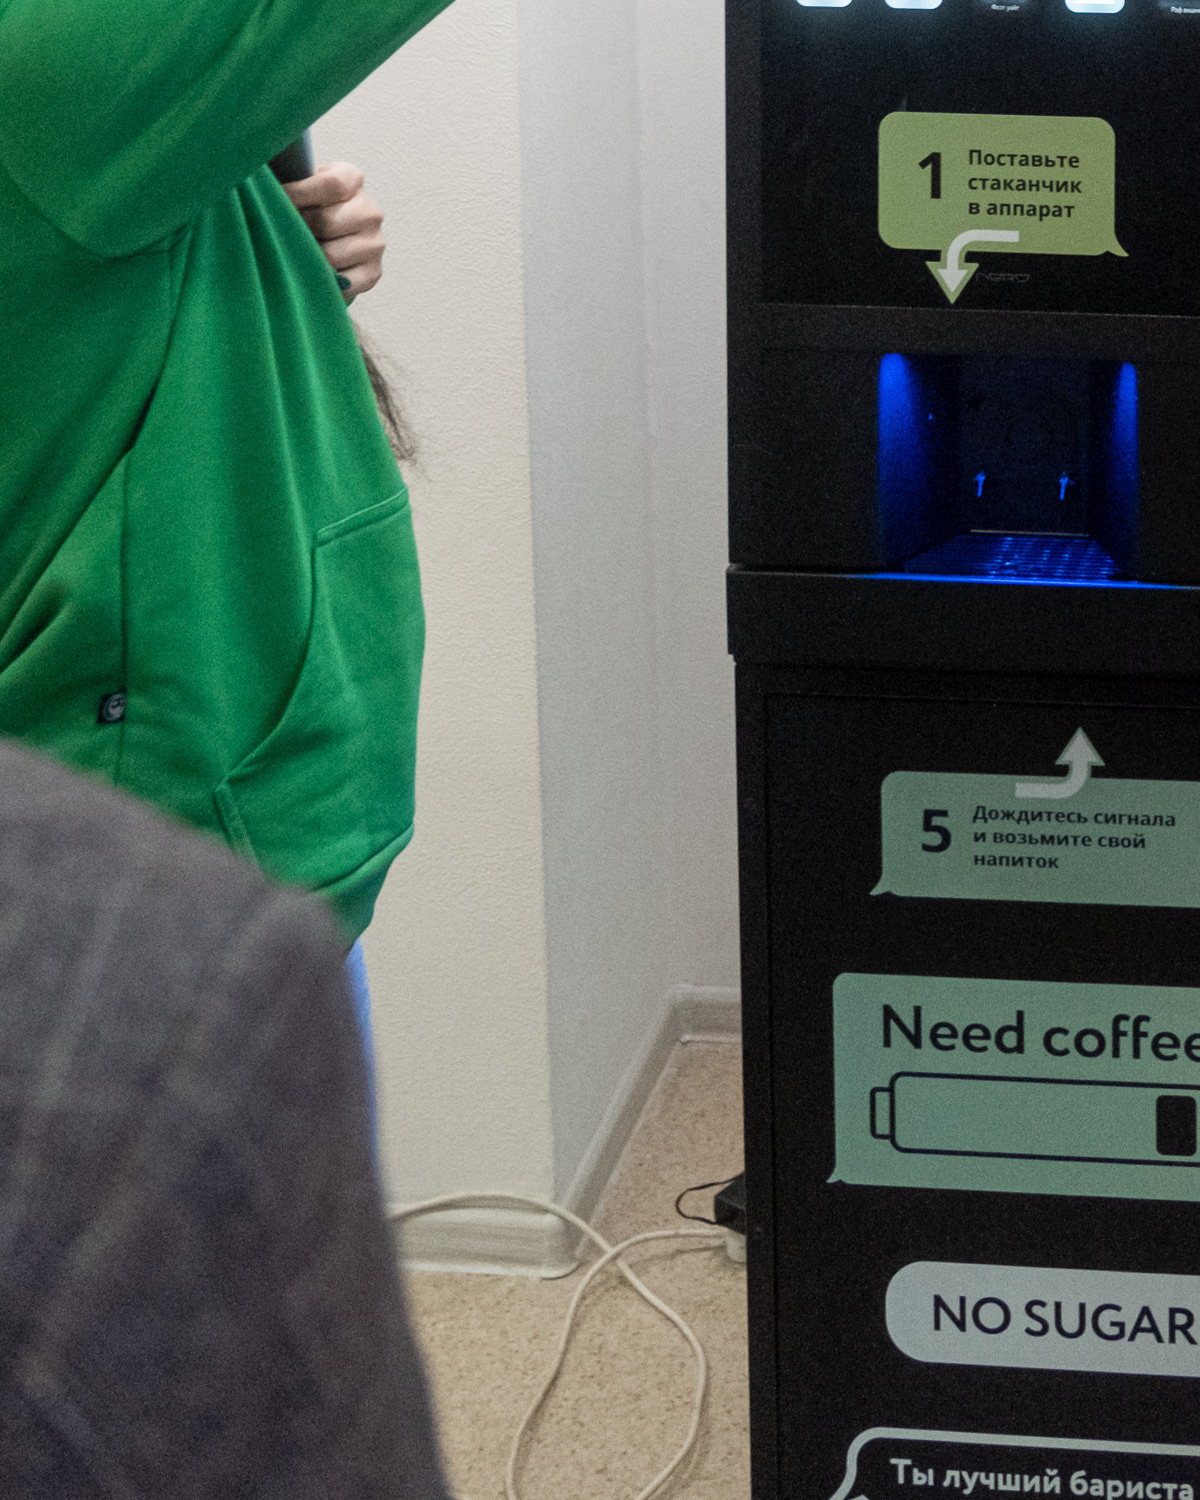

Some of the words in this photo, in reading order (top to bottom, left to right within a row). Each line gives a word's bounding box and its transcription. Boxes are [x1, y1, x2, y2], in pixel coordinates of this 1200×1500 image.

[968, 149, 1080, 168] Поставьте
[917, 151, 942, 199] 1
[967, 176, 1083, 194] стаканчик
[968, 202, 980, 215] в
[986, 202, 1075, 221] аппарат
[972, 805, 1088, 826] Дождитесь
[1093, 811, 1176, 828] сигнала
[921, 808, 952, 853] 5
[973, 830, 986, 844] и
[992, 831, 1093, 849] возьмите
[1097, 833, 1147, 850] свой
[973, 852, 1060, 870] напиток
[882, 1003, 1025, 1055] Need
[932, 1294, 1012, 1335] NO
[1023, 1299, 1199, 1345] SUGAR
[890, 1457, 935, 1487] Ты
[943, 1468, 1062, 1495] лучший
[1069, 1470, 1194, 1500] бариста
